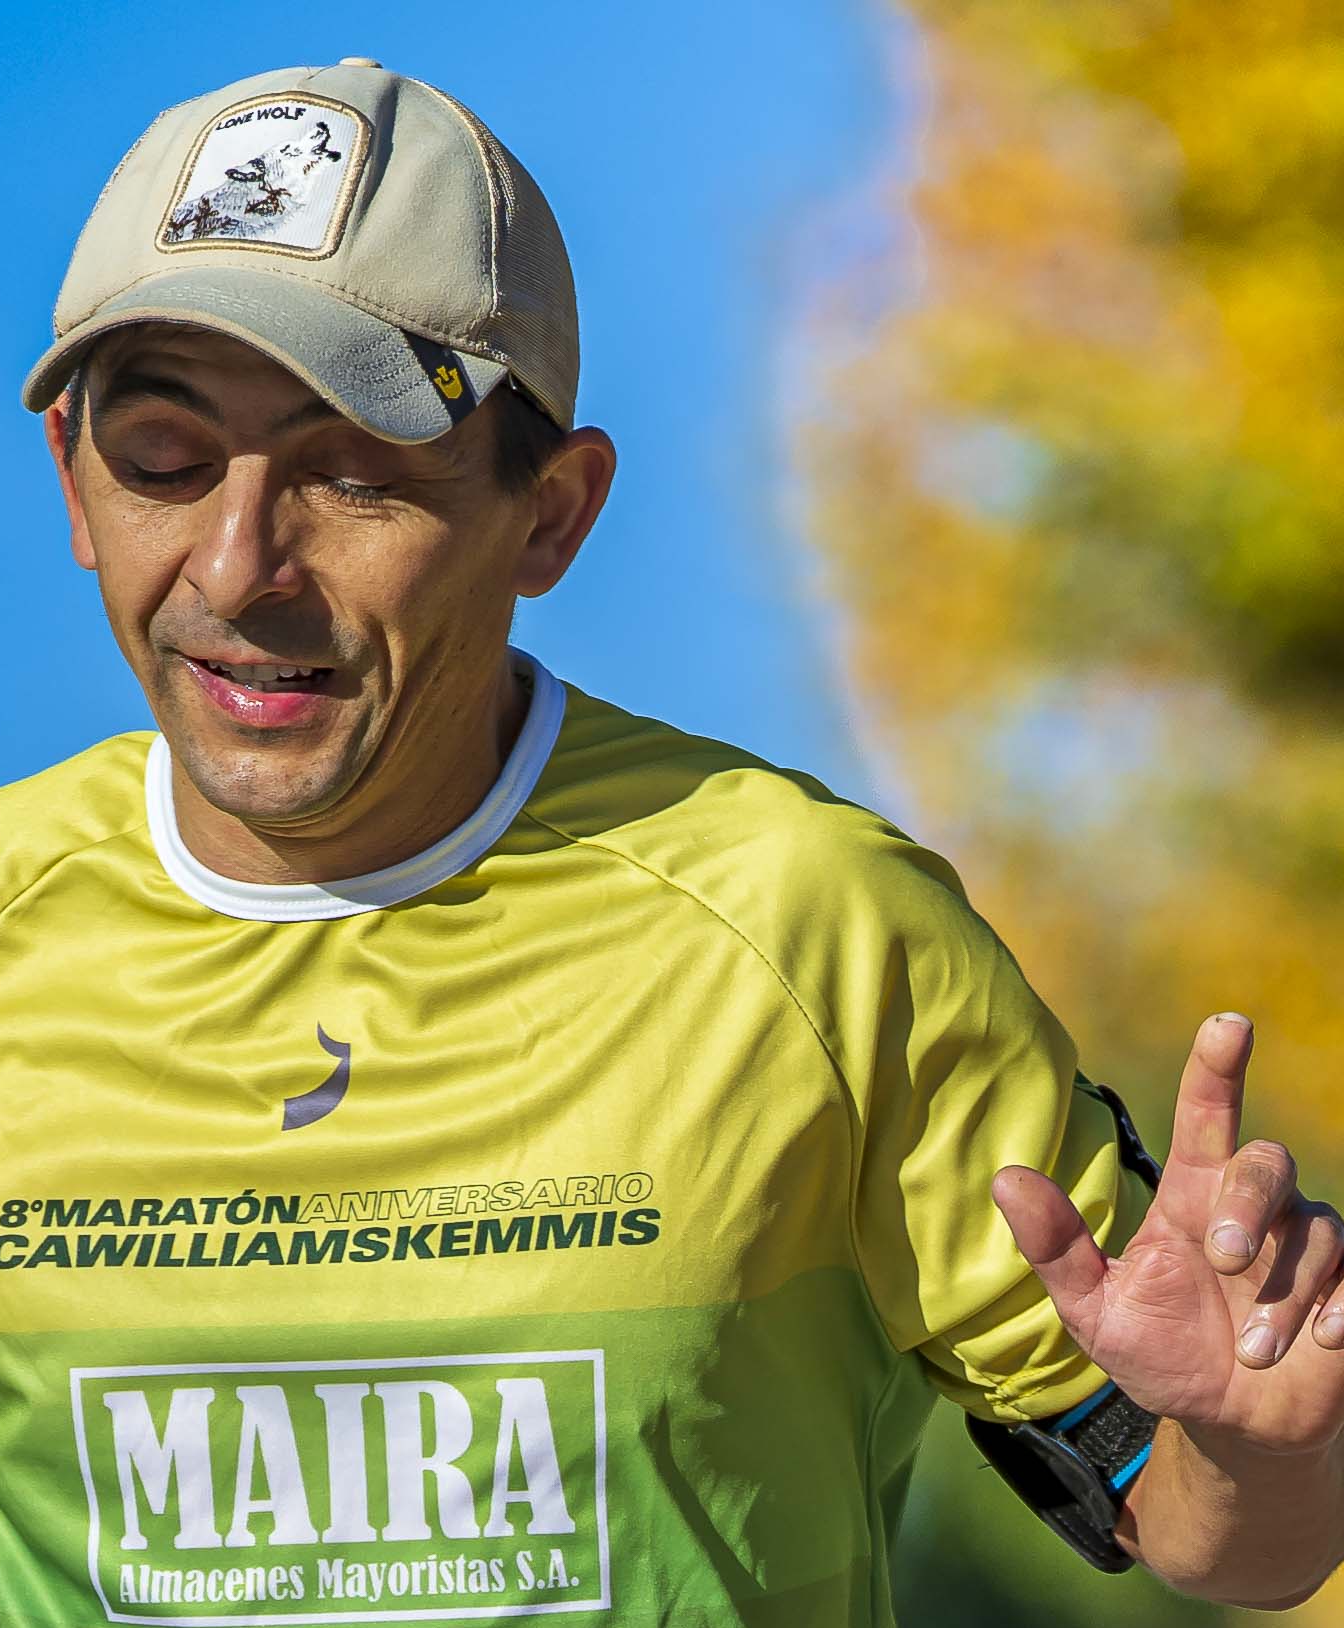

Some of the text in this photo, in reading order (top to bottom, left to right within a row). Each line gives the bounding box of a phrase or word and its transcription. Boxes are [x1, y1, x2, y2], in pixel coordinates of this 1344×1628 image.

[216, 107, 306, 130] LONE WOLF
[103, 1378, 576, 1550] MAIRA
[119, 1548, 580, 1604] Almacenes Mayoristas S.A.
